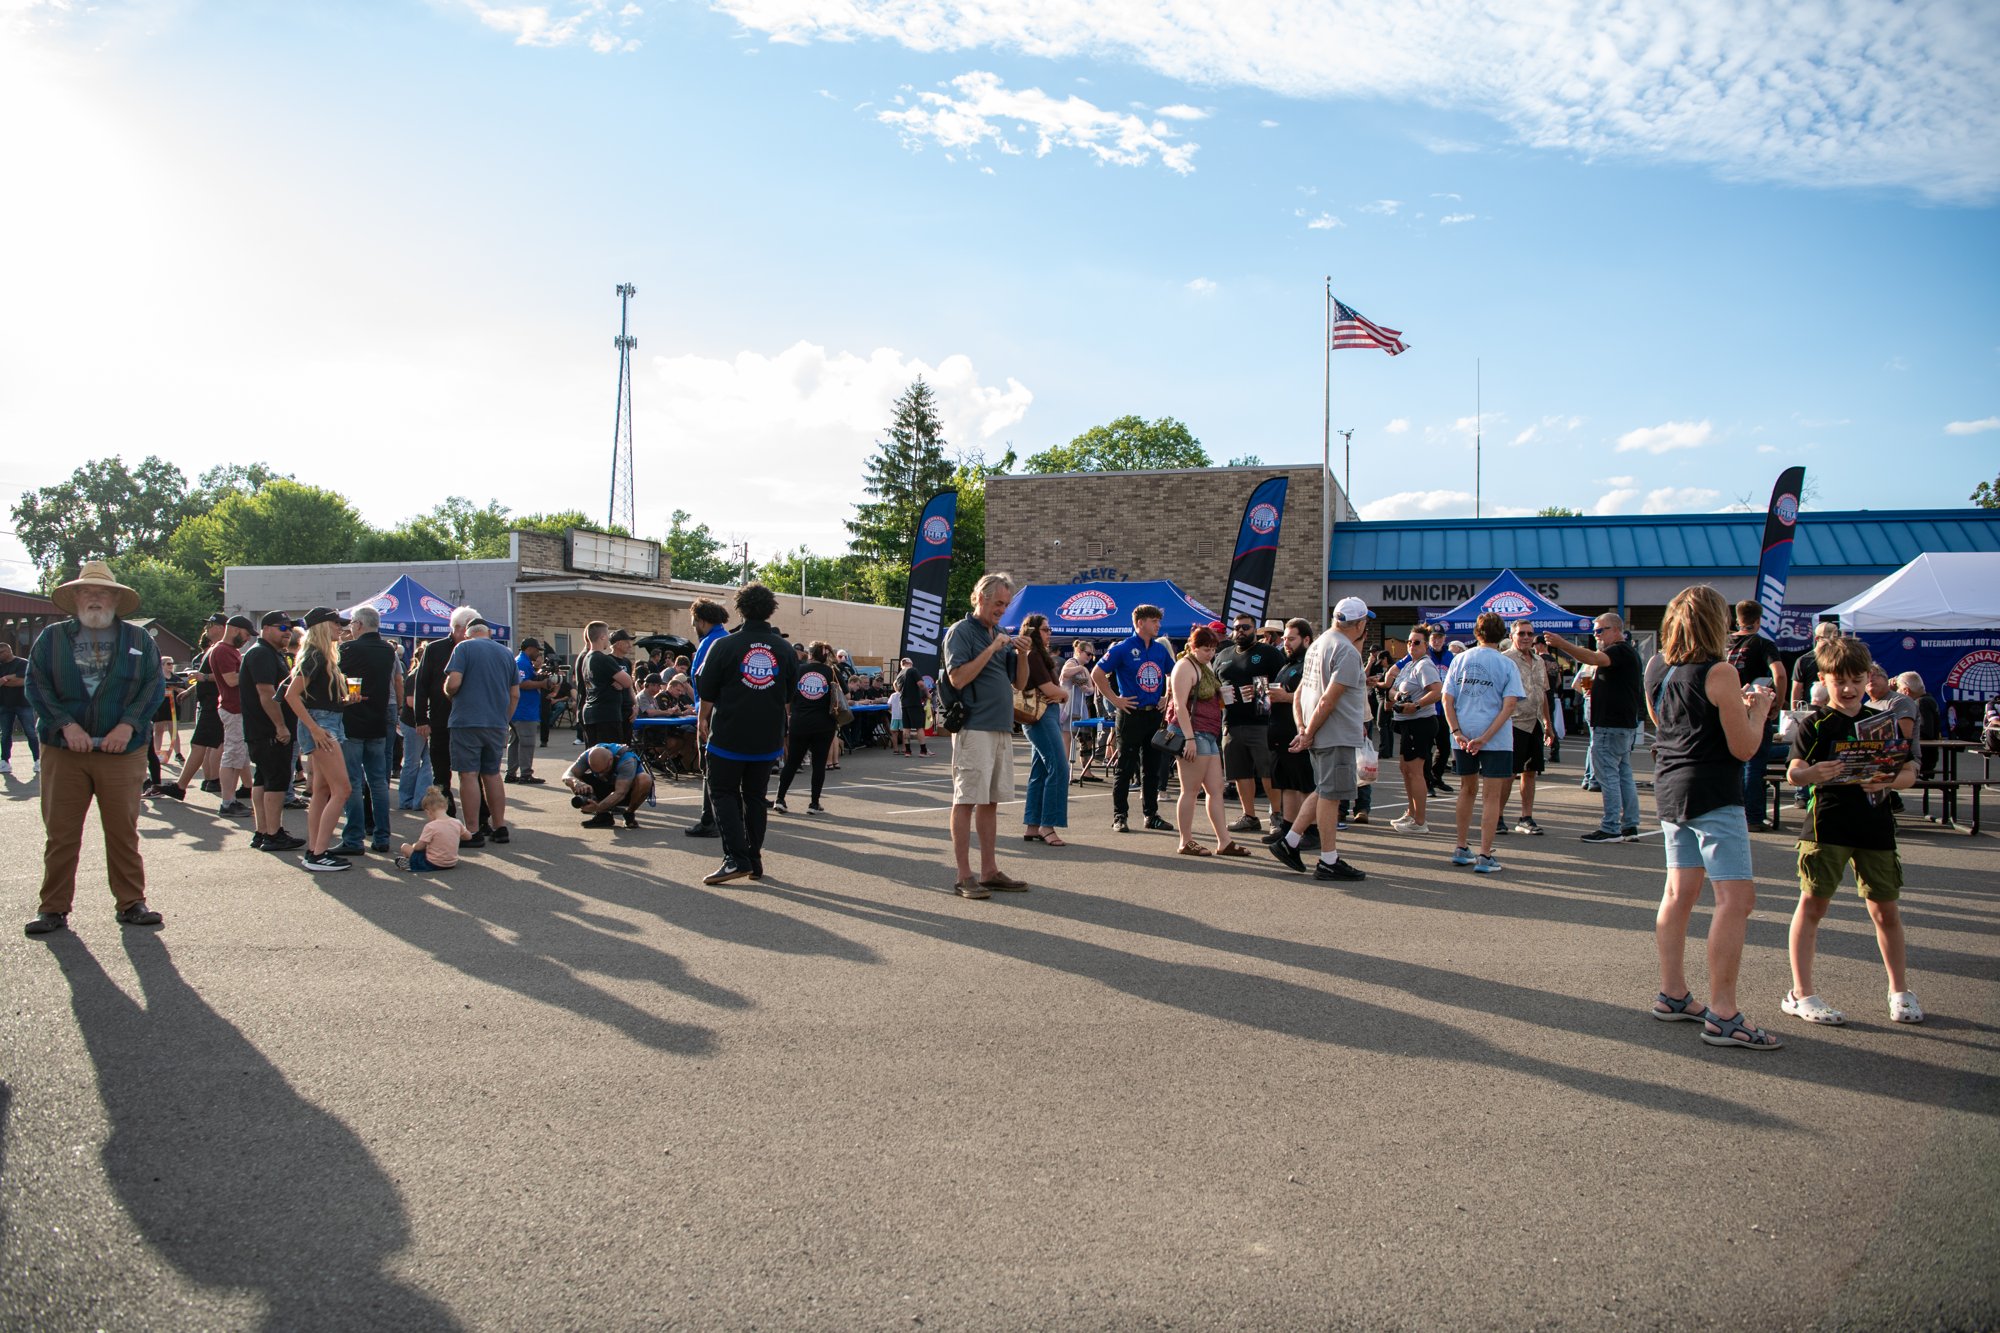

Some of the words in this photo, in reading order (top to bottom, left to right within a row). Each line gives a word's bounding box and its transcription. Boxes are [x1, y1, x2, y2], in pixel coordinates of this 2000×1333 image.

[1250, 518, 1276, 528] IHRA
[925, 530, 948, 539] IHRA
[1063, 591, 1115, 609] INTERNATIONAL
[906, 588, 943, 656] IHRA
[73, 642, 89, 653] EST
[1921, 638, 1973, 648] INTERNATIONAL
[1975, 638, 1990, 646] HOT
[1991, 639, 2000, 647] RO
[743, 648, 777, 667] INTERNATIONAL
[744, 666, 773, 676] IHRA
[1948, 652, 2000, 684] INTERNAT
[741, 678, 753, 688] MAKE
[759, 680, 776, 690] HAPPEN
